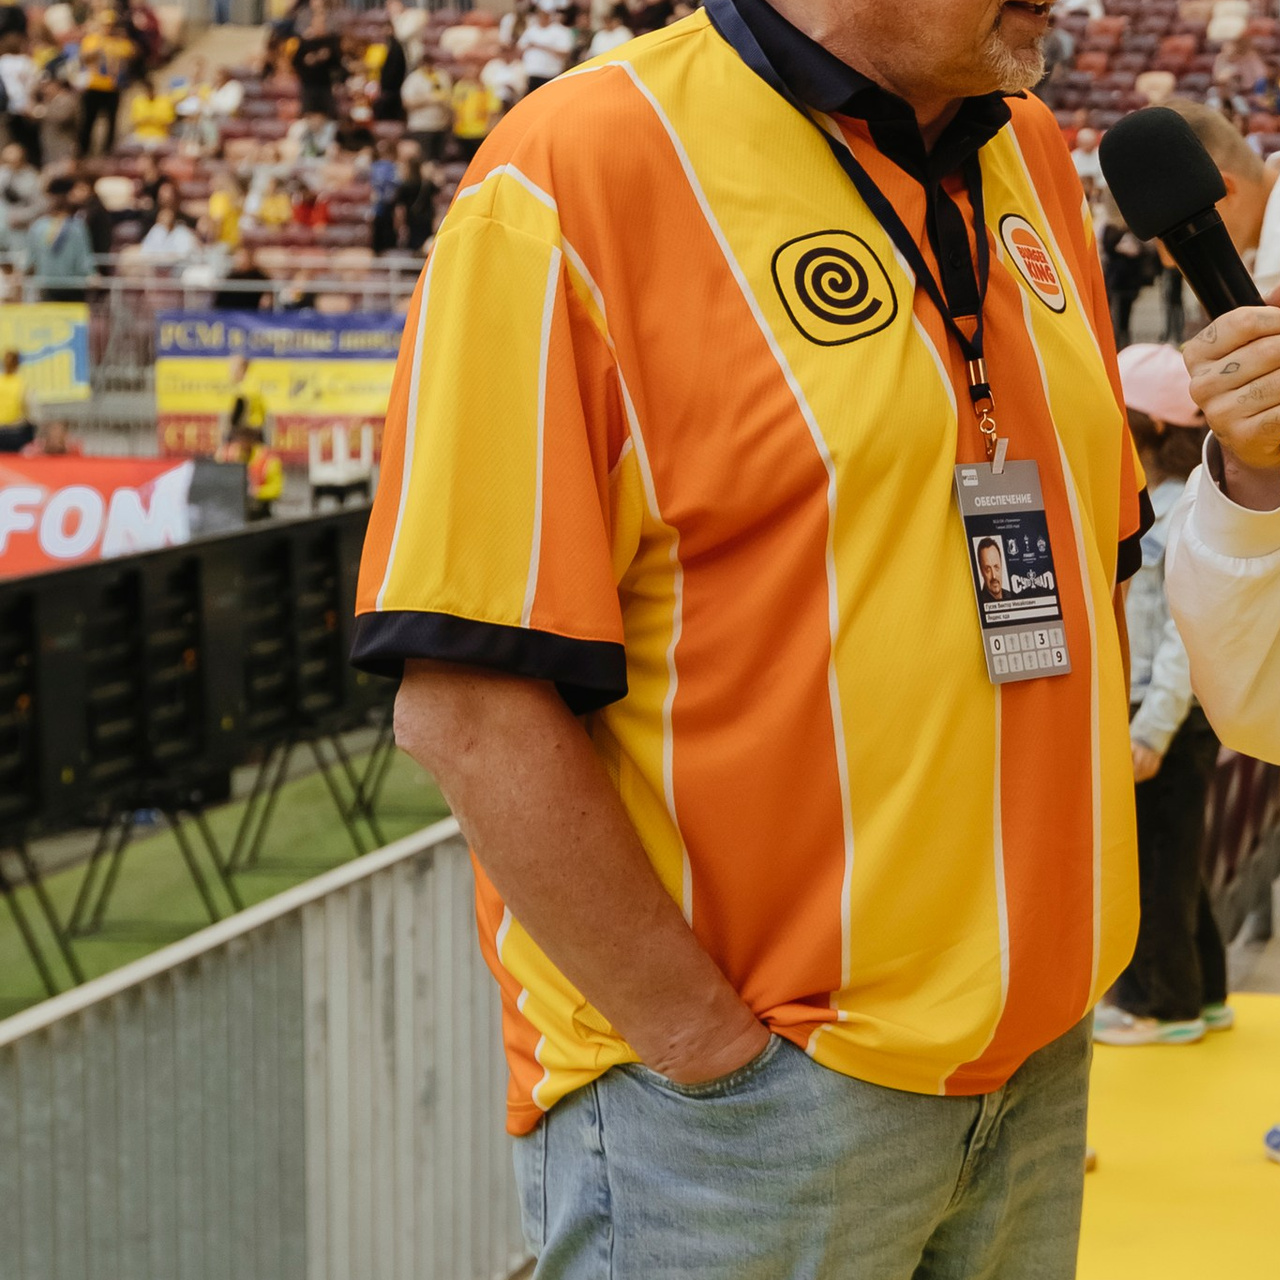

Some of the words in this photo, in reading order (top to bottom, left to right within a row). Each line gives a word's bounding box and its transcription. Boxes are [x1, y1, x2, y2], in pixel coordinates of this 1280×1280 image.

[1016, 245, 1048, 264] BURGER
[1023, 260, 1056, 285] KING
[974, 493, 1032, 507] ОБЕСПЕЧЕНИЕ
[993, 638, 1001, 651] 0
[1038, 633, 1045, 645] 3
[1055, 650, 1063, 663] 9
